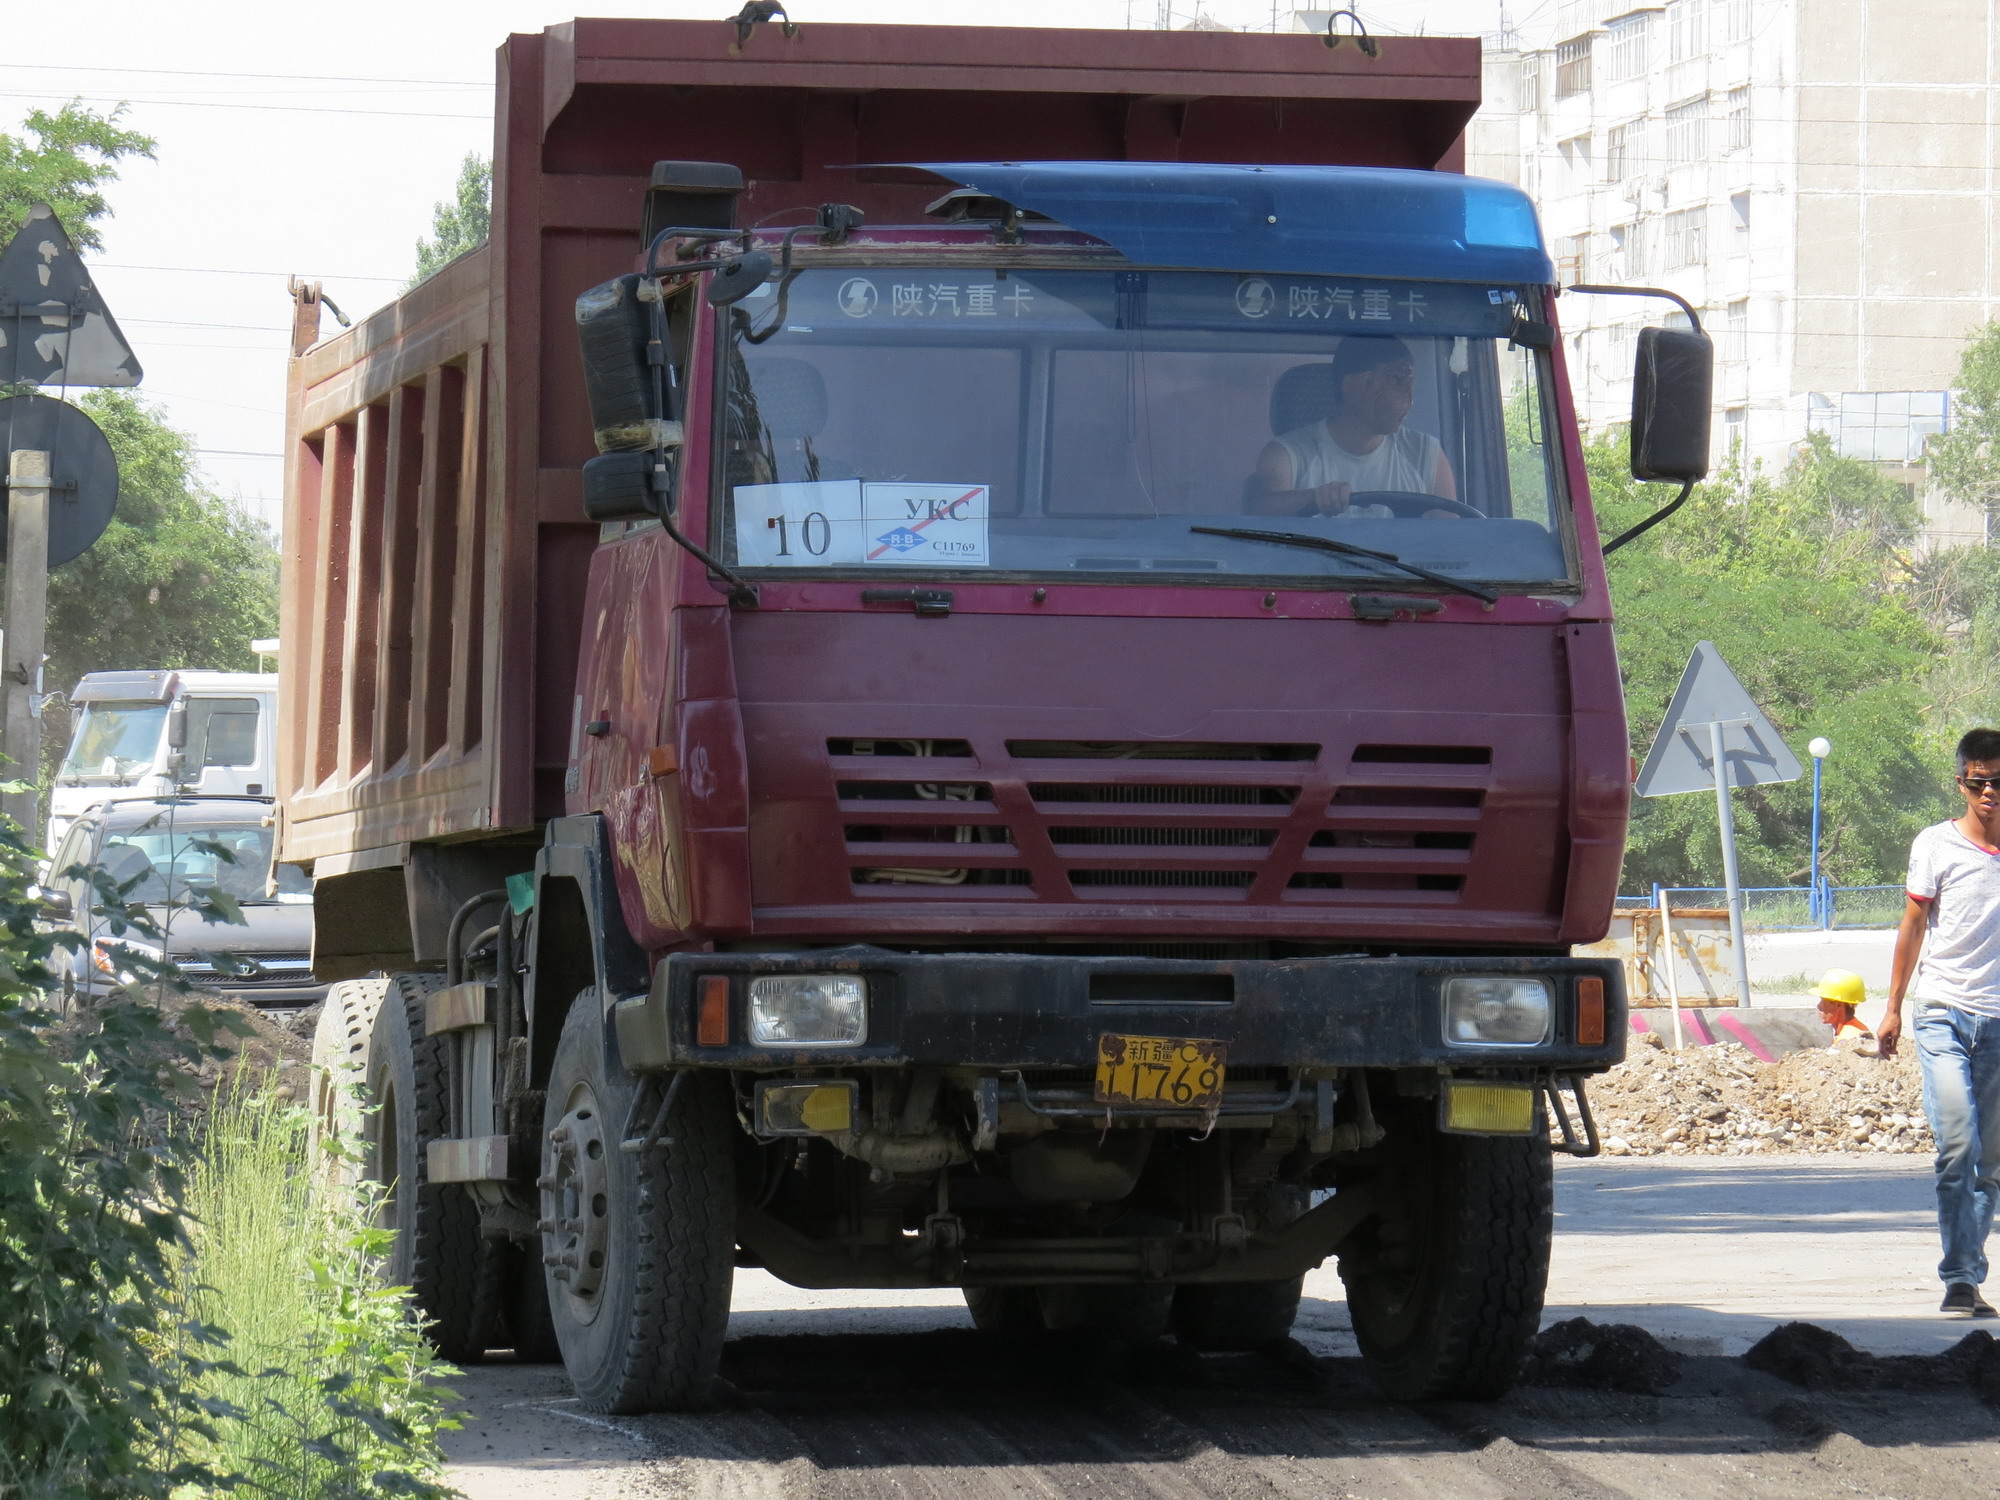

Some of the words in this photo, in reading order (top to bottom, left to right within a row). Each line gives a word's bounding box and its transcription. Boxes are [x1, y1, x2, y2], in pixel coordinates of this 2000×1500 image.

[892, 283, 1035, 317] 陕汽重卡
[1288, 285, 1428, 323] 陕汽重卡
[904, 498, 970, 522] УКС
[774, 511, 832, 557] 10
[1106, 1061, 1220, 1105] 11769
